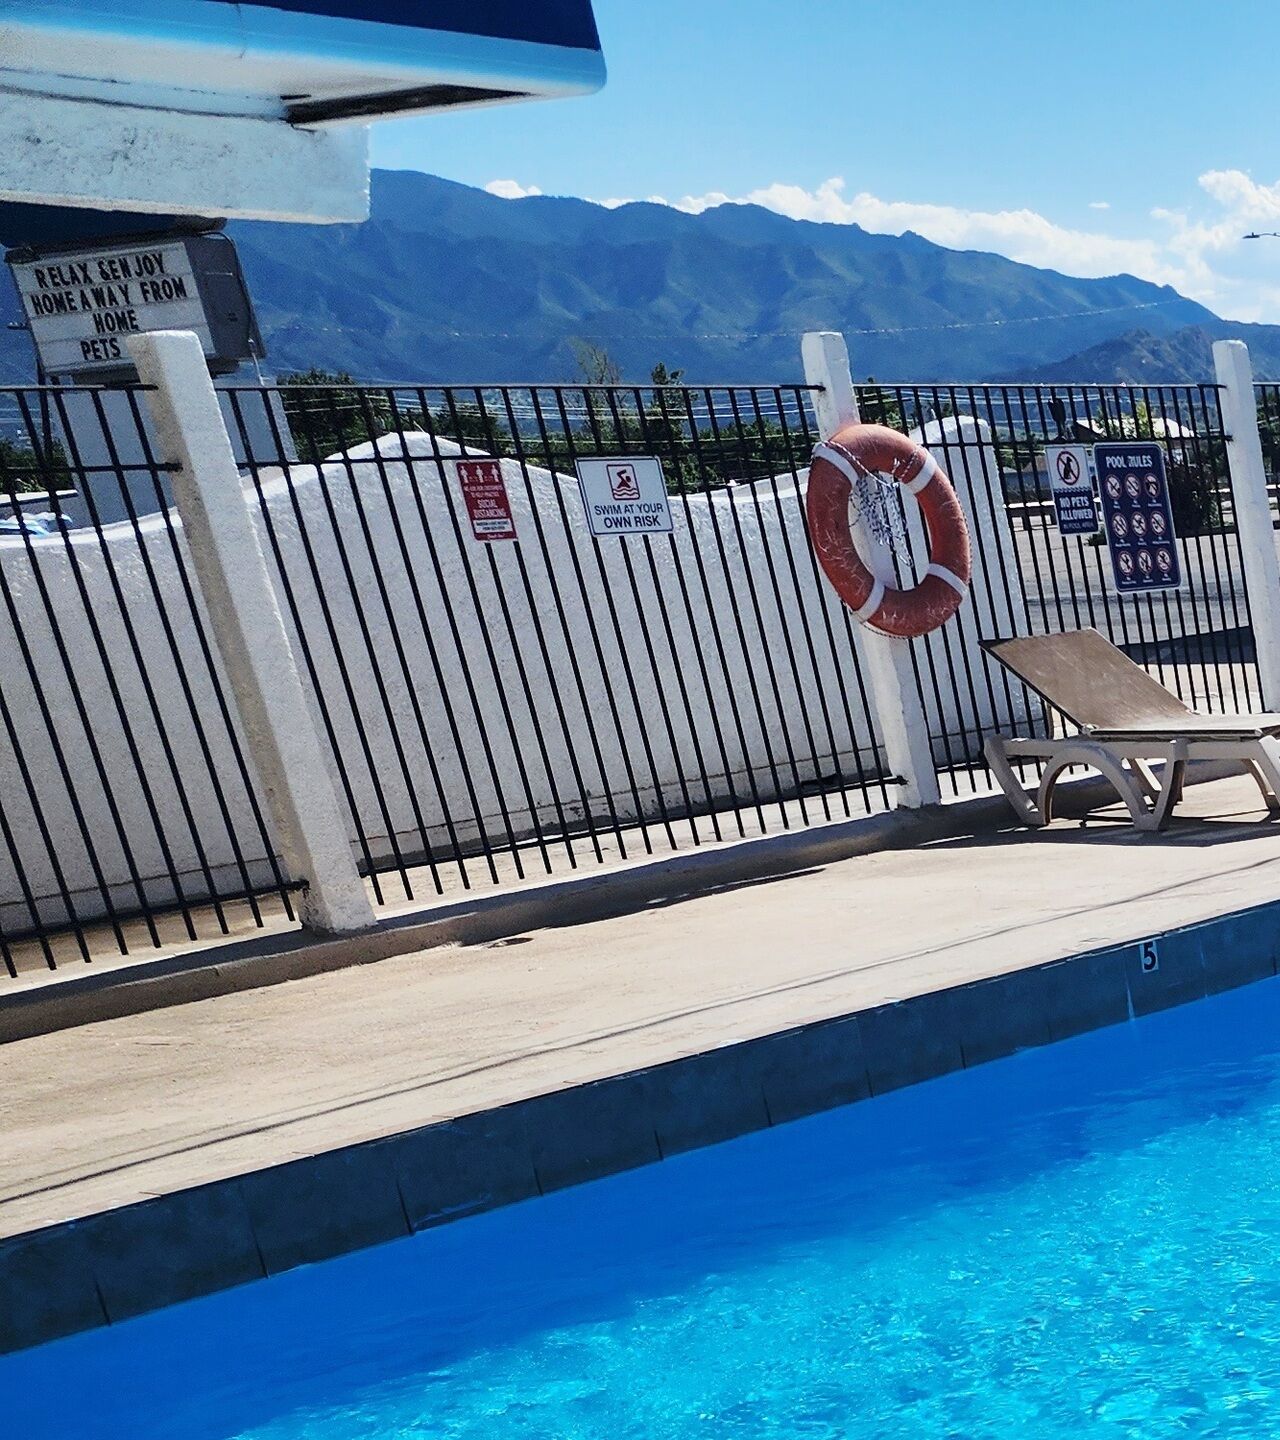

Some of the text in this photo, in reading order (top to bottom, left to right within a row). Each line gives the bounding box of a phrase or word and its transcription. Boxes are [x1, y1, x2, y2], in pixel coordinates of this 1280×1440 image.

[34, 262, 93, 289] RELAX
[140, 277, 187, 303] FROM
[92, 309, 140, 334] HOME
[80, 337, 121, 361] PETS
[1105, 454, 1153, 468] POOL RULES
[477, 499, 498, 509] SOCIAL
[594, 502, 664, 516] SWIM AT YOUR
[1059, 496, 1089, 508] NO PETS
[603, 514, 661, 529] OWN RISK
[1060, 508, 1094, 521] ALLOWED
[1143, 942, 1157, 971] 5
